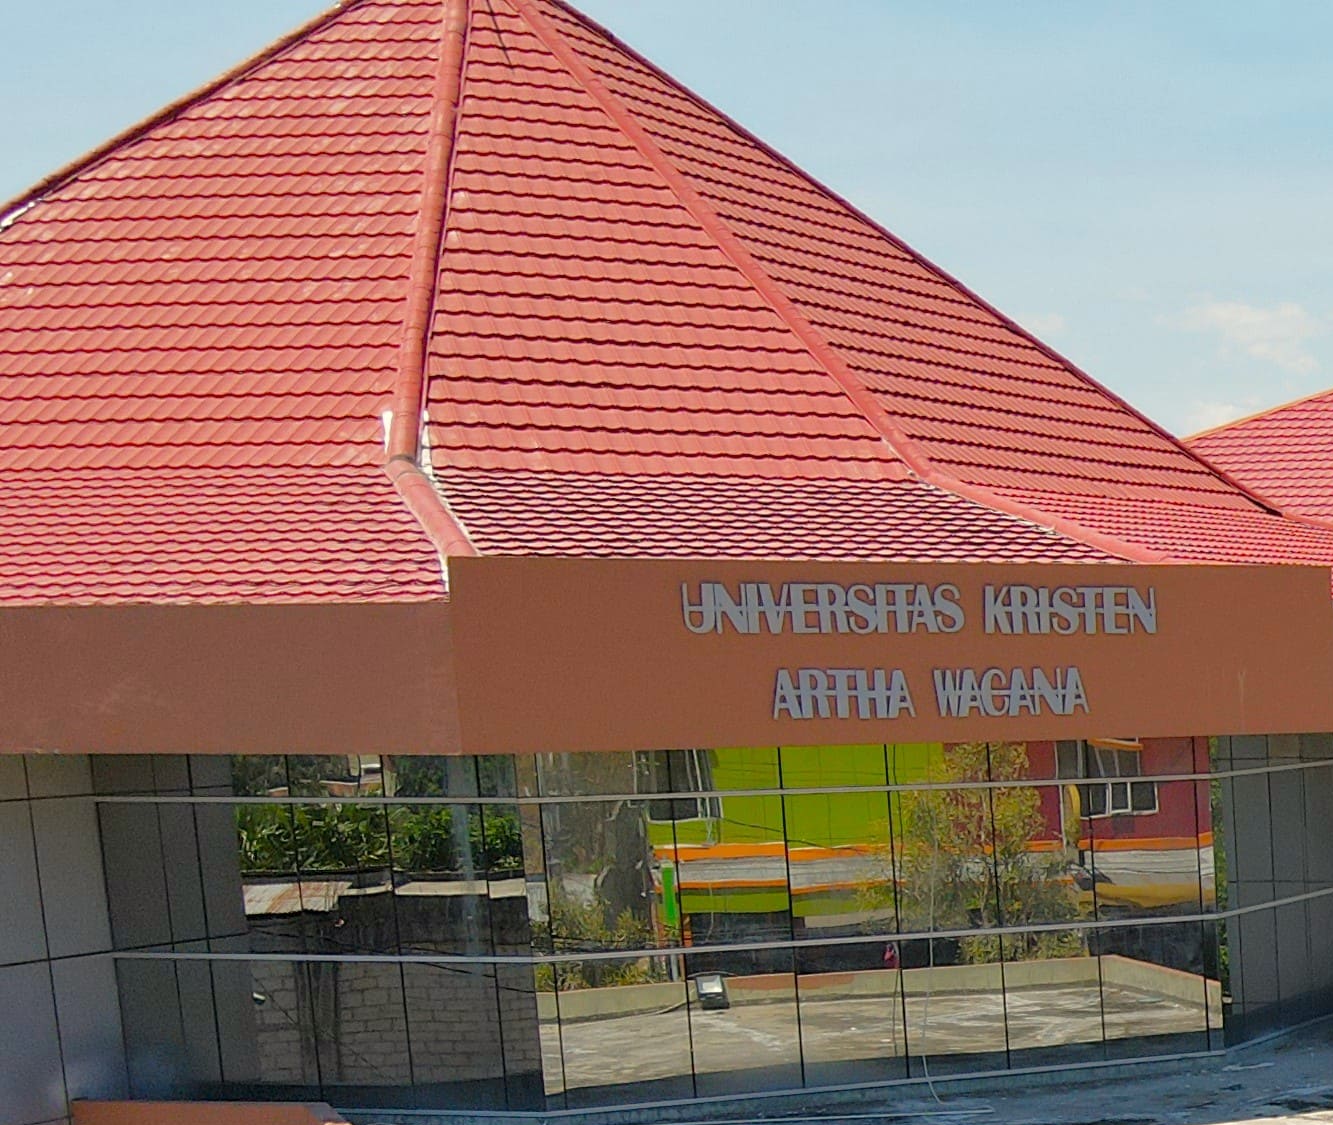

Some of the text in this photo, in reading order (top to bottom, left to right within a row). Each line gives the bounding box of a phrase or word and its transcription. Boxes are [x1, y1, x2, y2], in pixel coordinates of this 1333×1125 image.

[682, 582, 1158, 635] UNIVERSITAS KRISTEN
[773, 667, 1090, 720] ARTHA WACANA
